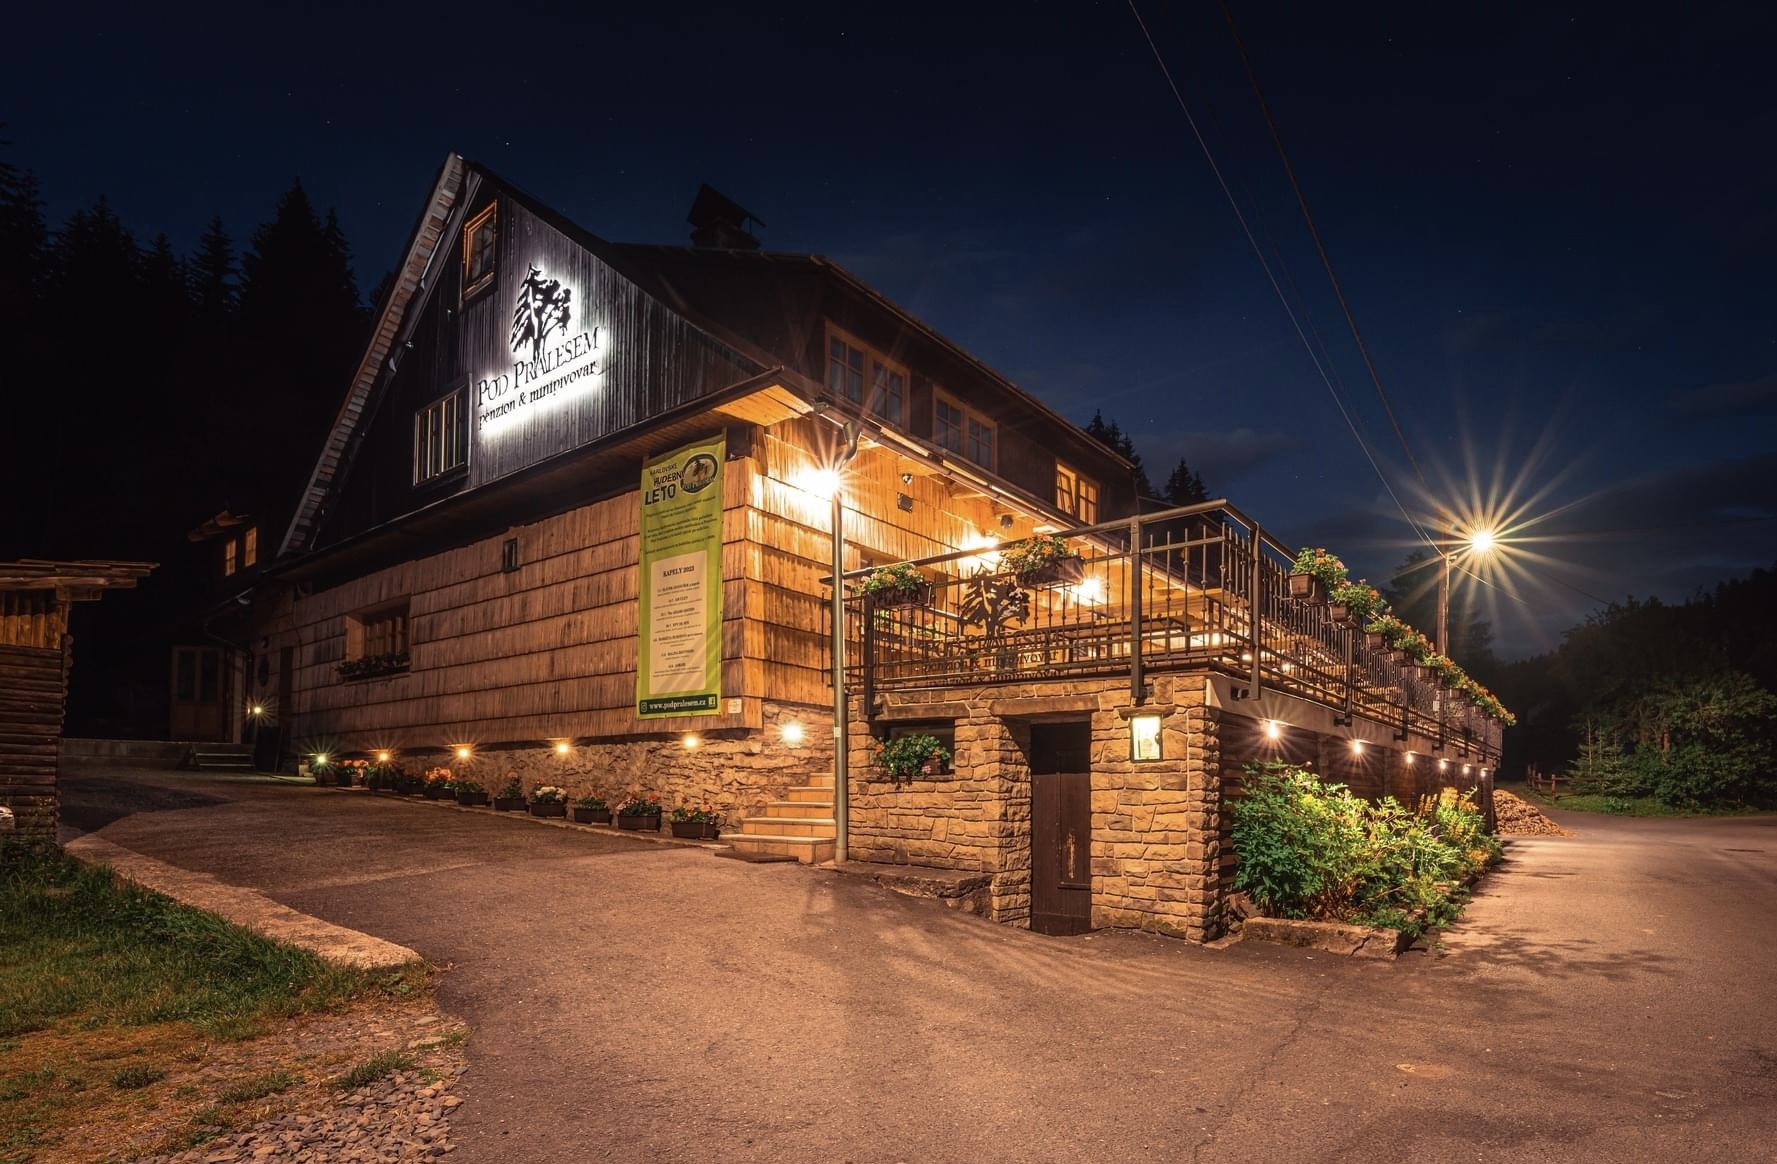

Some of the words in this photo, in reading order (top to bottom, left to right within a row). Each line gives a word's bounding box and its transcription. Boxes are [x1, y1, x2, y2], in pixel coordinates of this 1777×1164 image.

[478, 374, 508, 408] POD
[513, 326, 599, 389] PRALESEM
[479, 399, 515, 430] penzion
[519, 391, 526, 406] &
[529, 360, 597, 403] minipivovar
[649, 699, 706, 710] www.podpralesem.cz
